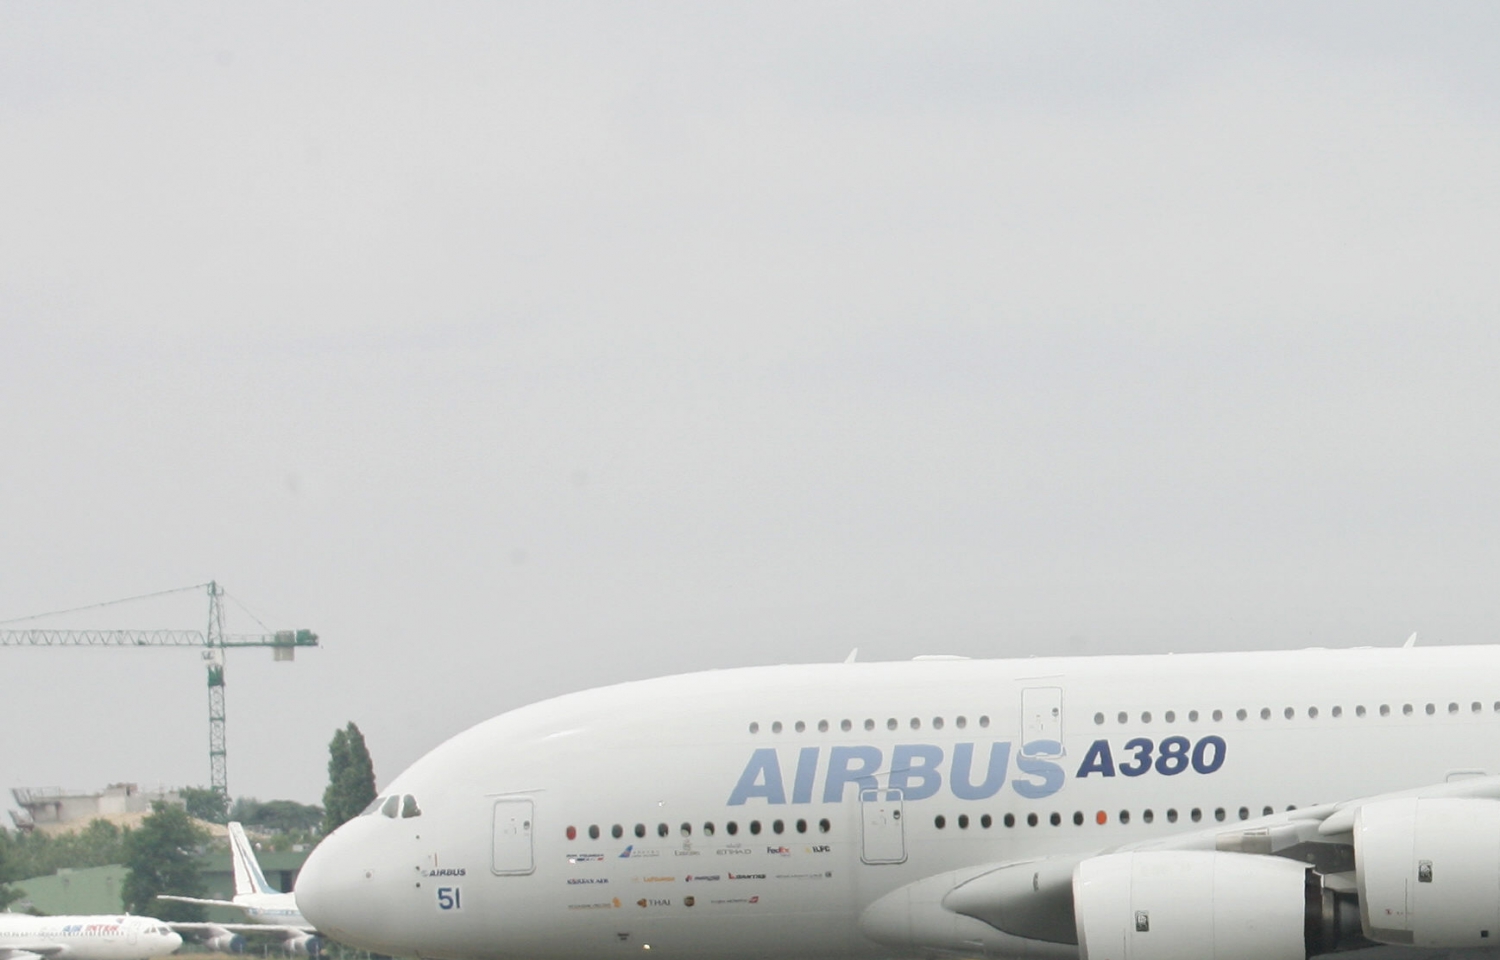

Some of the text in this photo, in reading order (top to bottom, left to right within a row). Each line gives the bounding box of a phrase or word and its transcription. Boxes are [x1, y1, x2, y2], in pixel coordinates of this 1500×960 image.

[726, 735, 1226, 807] AIRBUS A380
[429, 868, 466, 877] AIRBUS
[437, 887, 461, 910] 51
